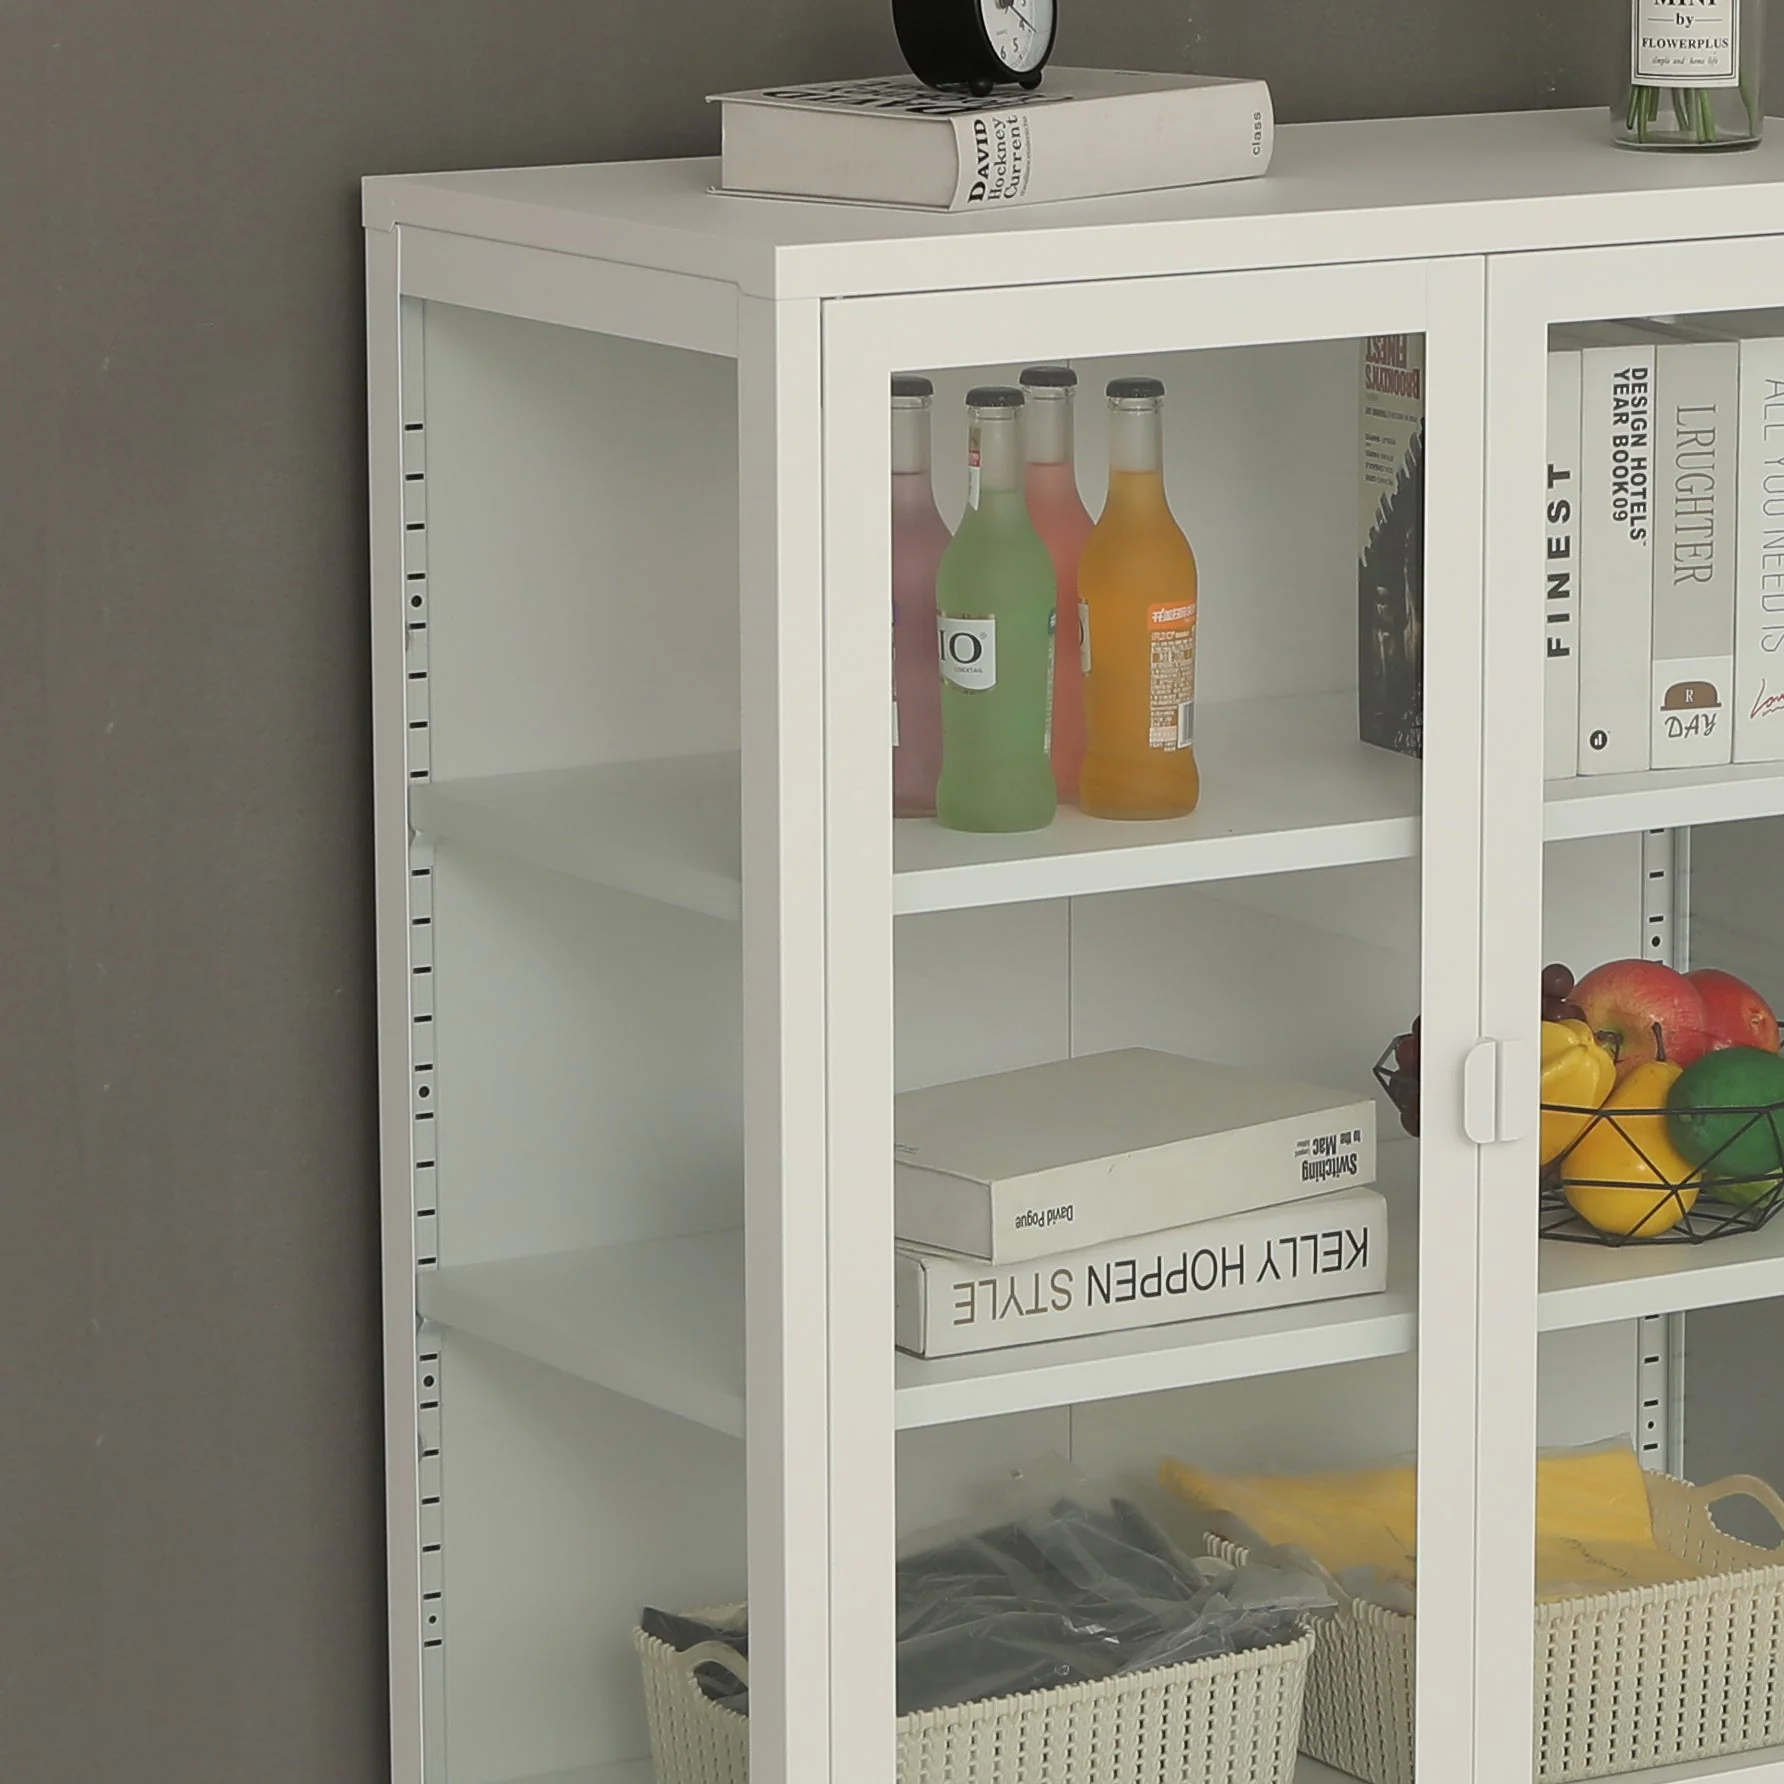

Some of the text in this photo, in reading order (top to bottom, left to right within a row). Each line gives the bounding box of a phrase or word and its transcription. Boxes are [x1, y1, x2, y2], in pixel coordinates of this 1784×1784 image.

[1676, 12, 1694, 28] by
[1000, 45, 1006, 60] 6
[1013, 37, 1019, 52] 5
[1642, 37, 1729, 49] FLOWERPLUS
[1252, 111, 1262, 155] class
[967, 119, 989, 203] DAVID
[987, 117, 1006, 200] Hockney
[1003, 115, 1022, 199] Current
[1612, 367, 1630, 425] YEAR
[1630, 367, 1649, 541] DESIGN HOTELS
[1673, 404, 1717, 586] LRUGHTER
[1547, 463, 1571, 658] FINEST
[1685, 688, 1695, 704] R
[1664, 713, 1717, 739] DAY
[1312, 1134, 1337, 1156] Mac
[1301, 1152, 1358, 1183] Switching
[1015, 1204, 1073, 1229] David Pogue
[952, 1226, 1369, 1326] KELLY HOPPEN STYLE
